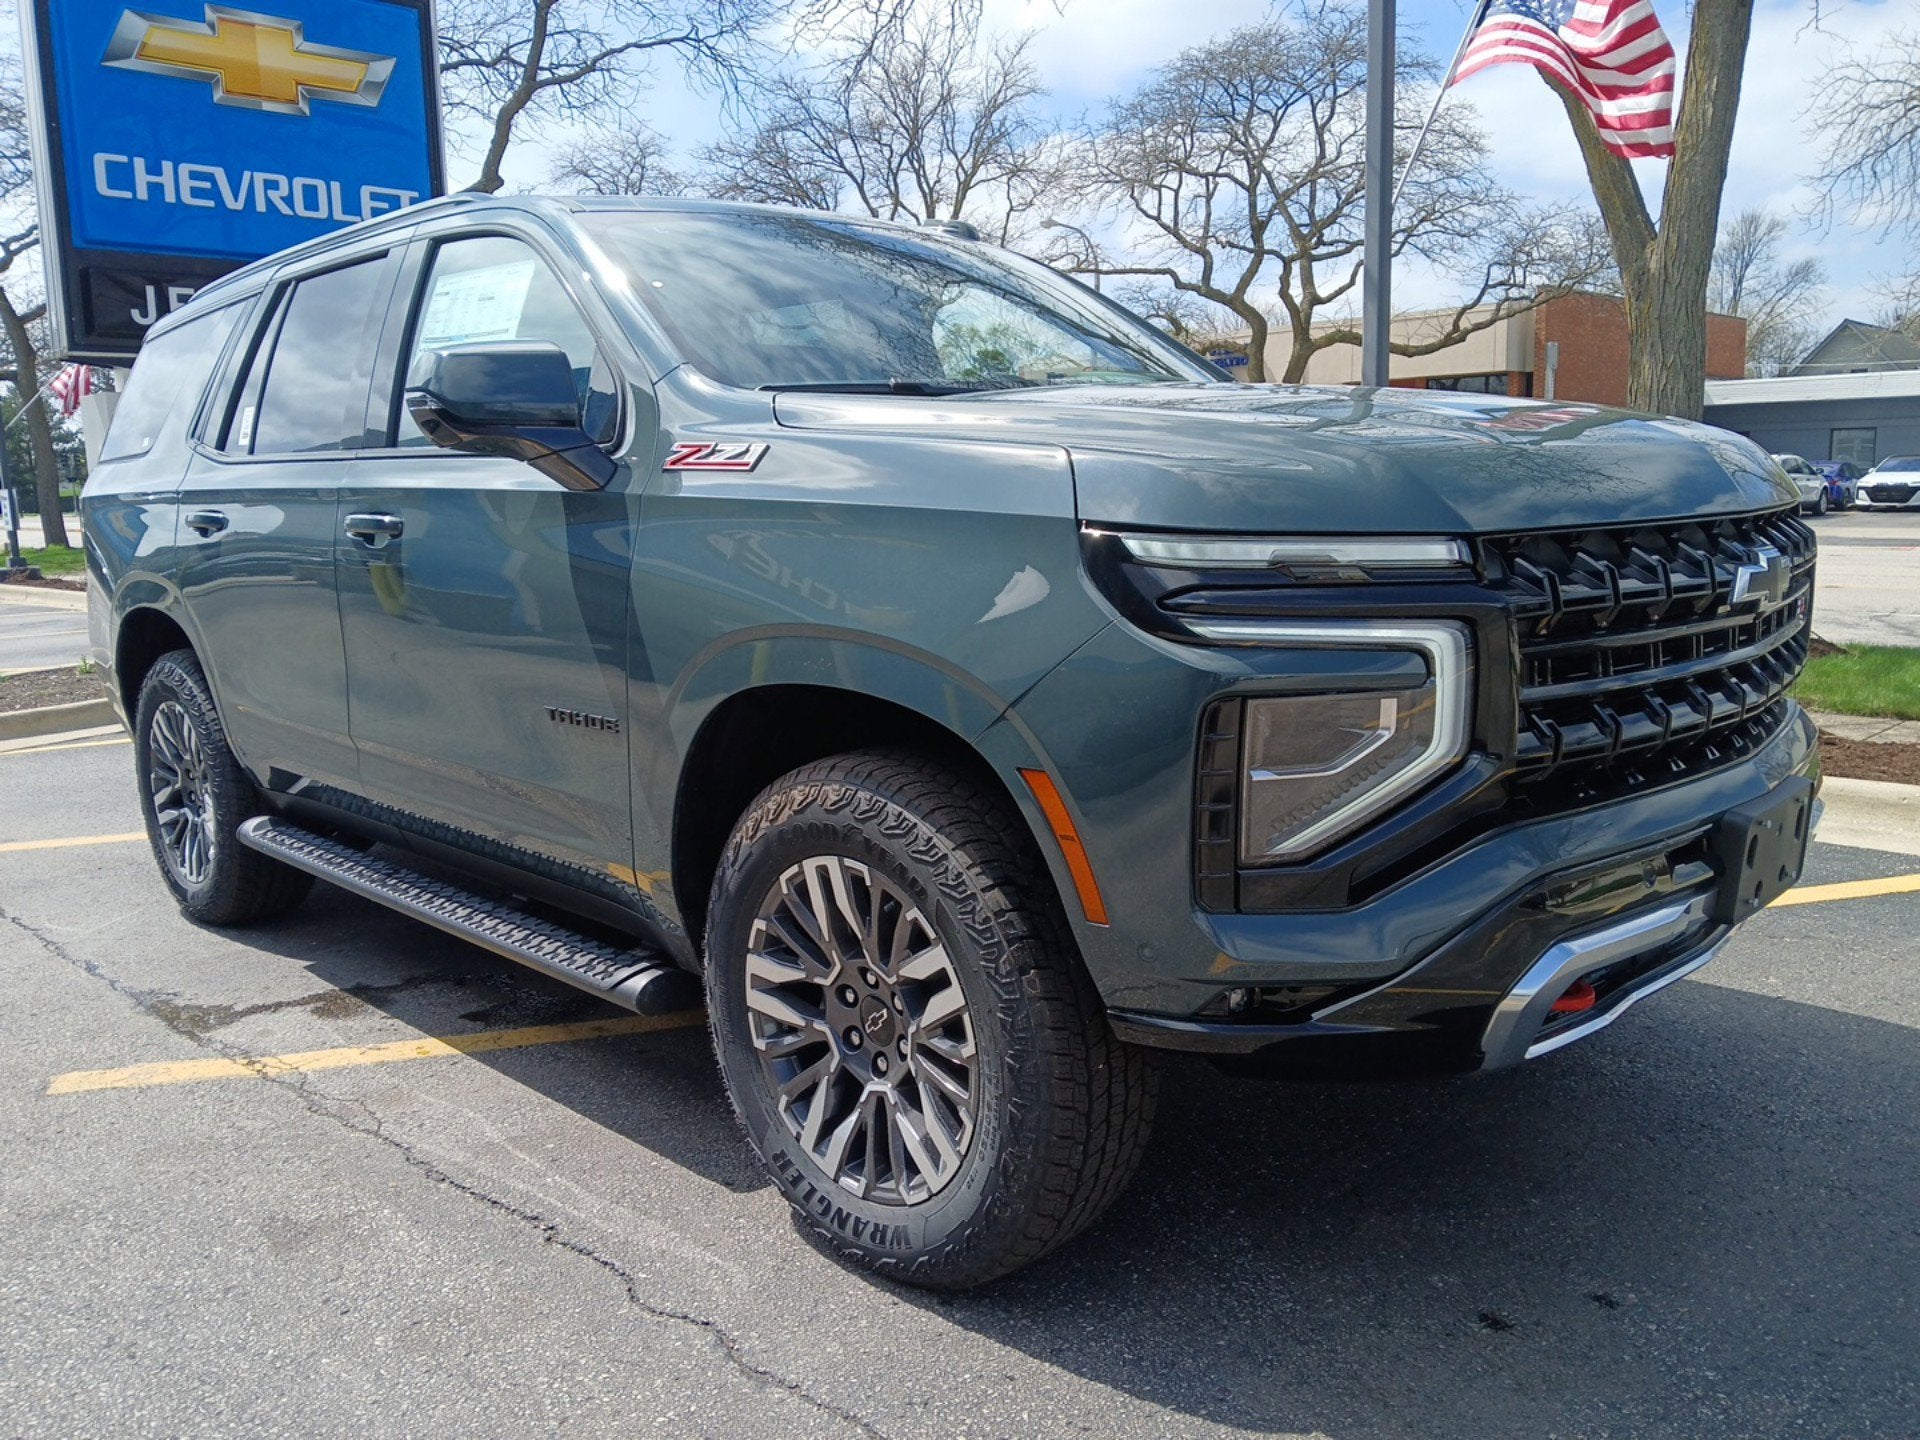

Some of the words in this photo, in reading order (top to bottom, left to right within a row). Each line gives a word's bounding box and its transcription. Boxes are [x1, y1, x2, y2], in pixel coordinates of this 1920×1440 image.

[93, 152, 419, 223] CHEVROLET
[661, 441, 771, 473] Z71
[543, 704, 621, 734] TAHOE
[771, 1148, 913, 1250] WRANGLER
